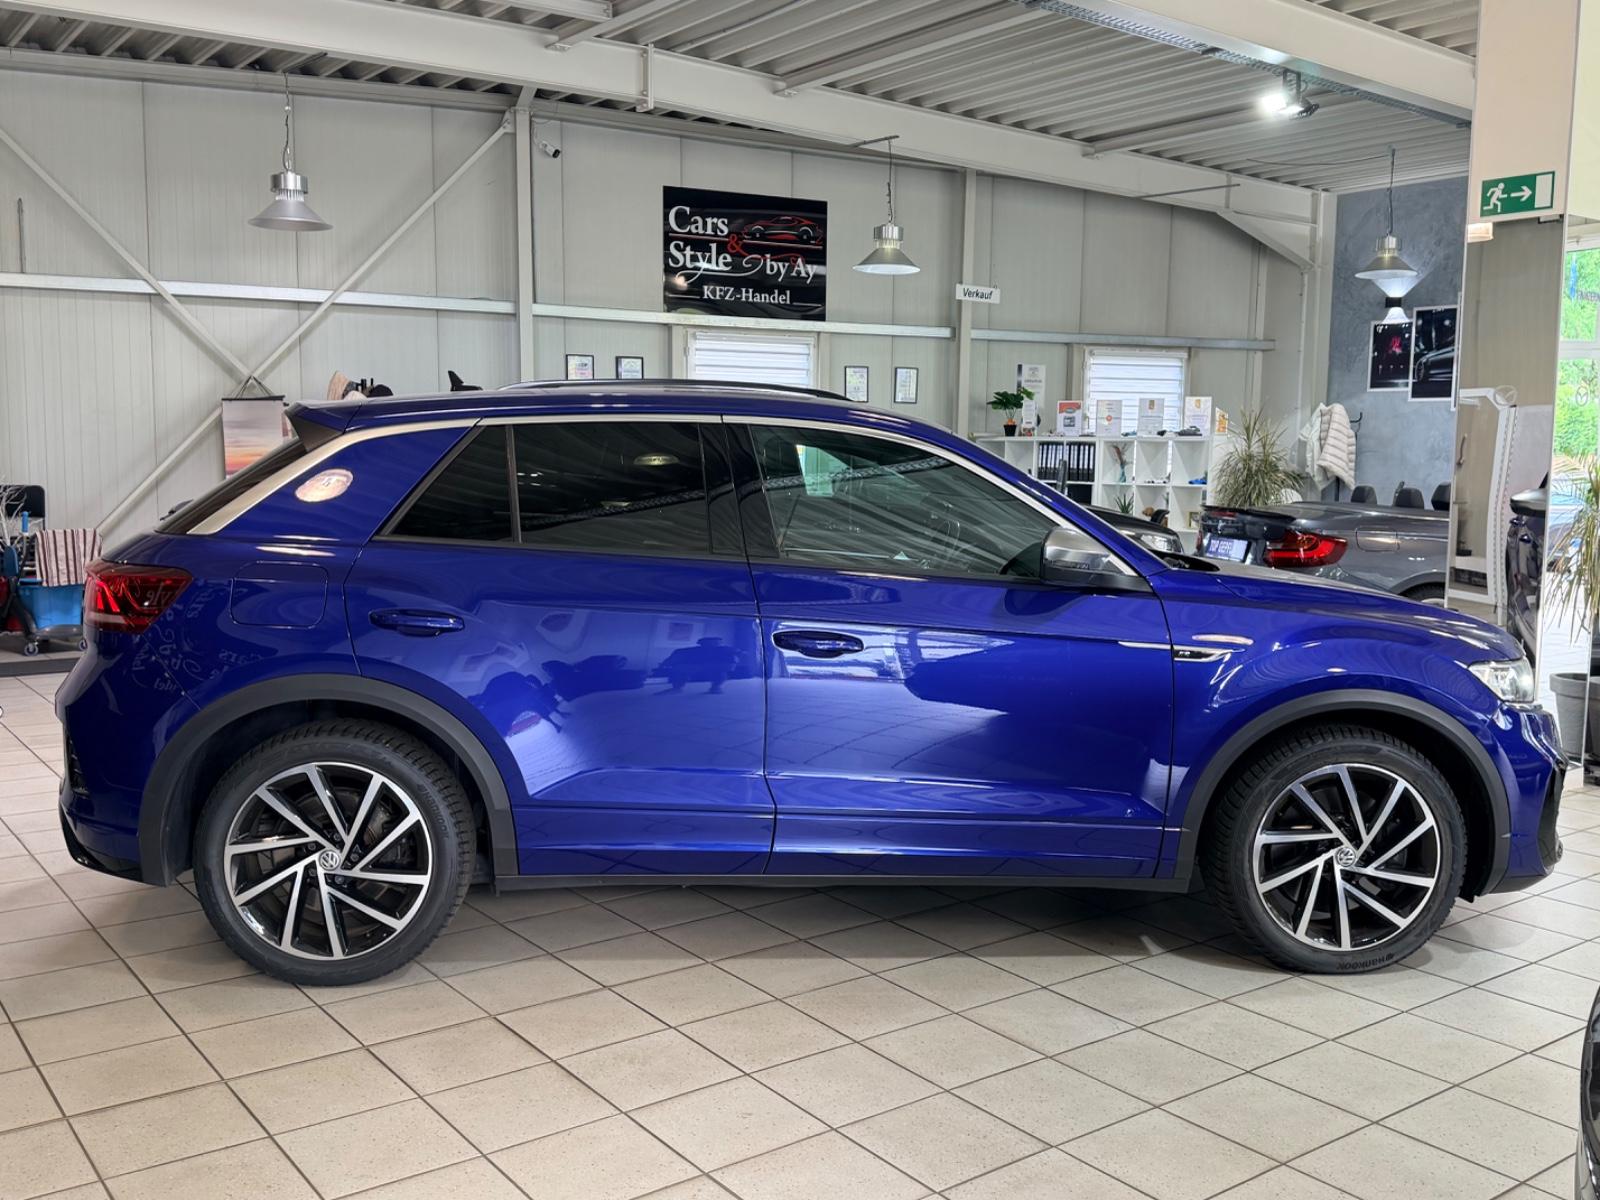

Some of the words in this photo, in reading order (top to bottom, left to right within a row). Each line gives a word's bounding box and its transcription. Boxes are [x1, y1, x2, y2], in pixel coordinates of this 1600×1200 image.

[668, 205, 729, 236] Cars
[726, 233, 744, 254] &
[668, 240, 733, 280] Style
[765, 254, 790, 282] by
[790, 257, 817, 285] Ay
[702, 285, 791, 305] KFZ-Handel
[963, 287, 993, 300] Verkauf
